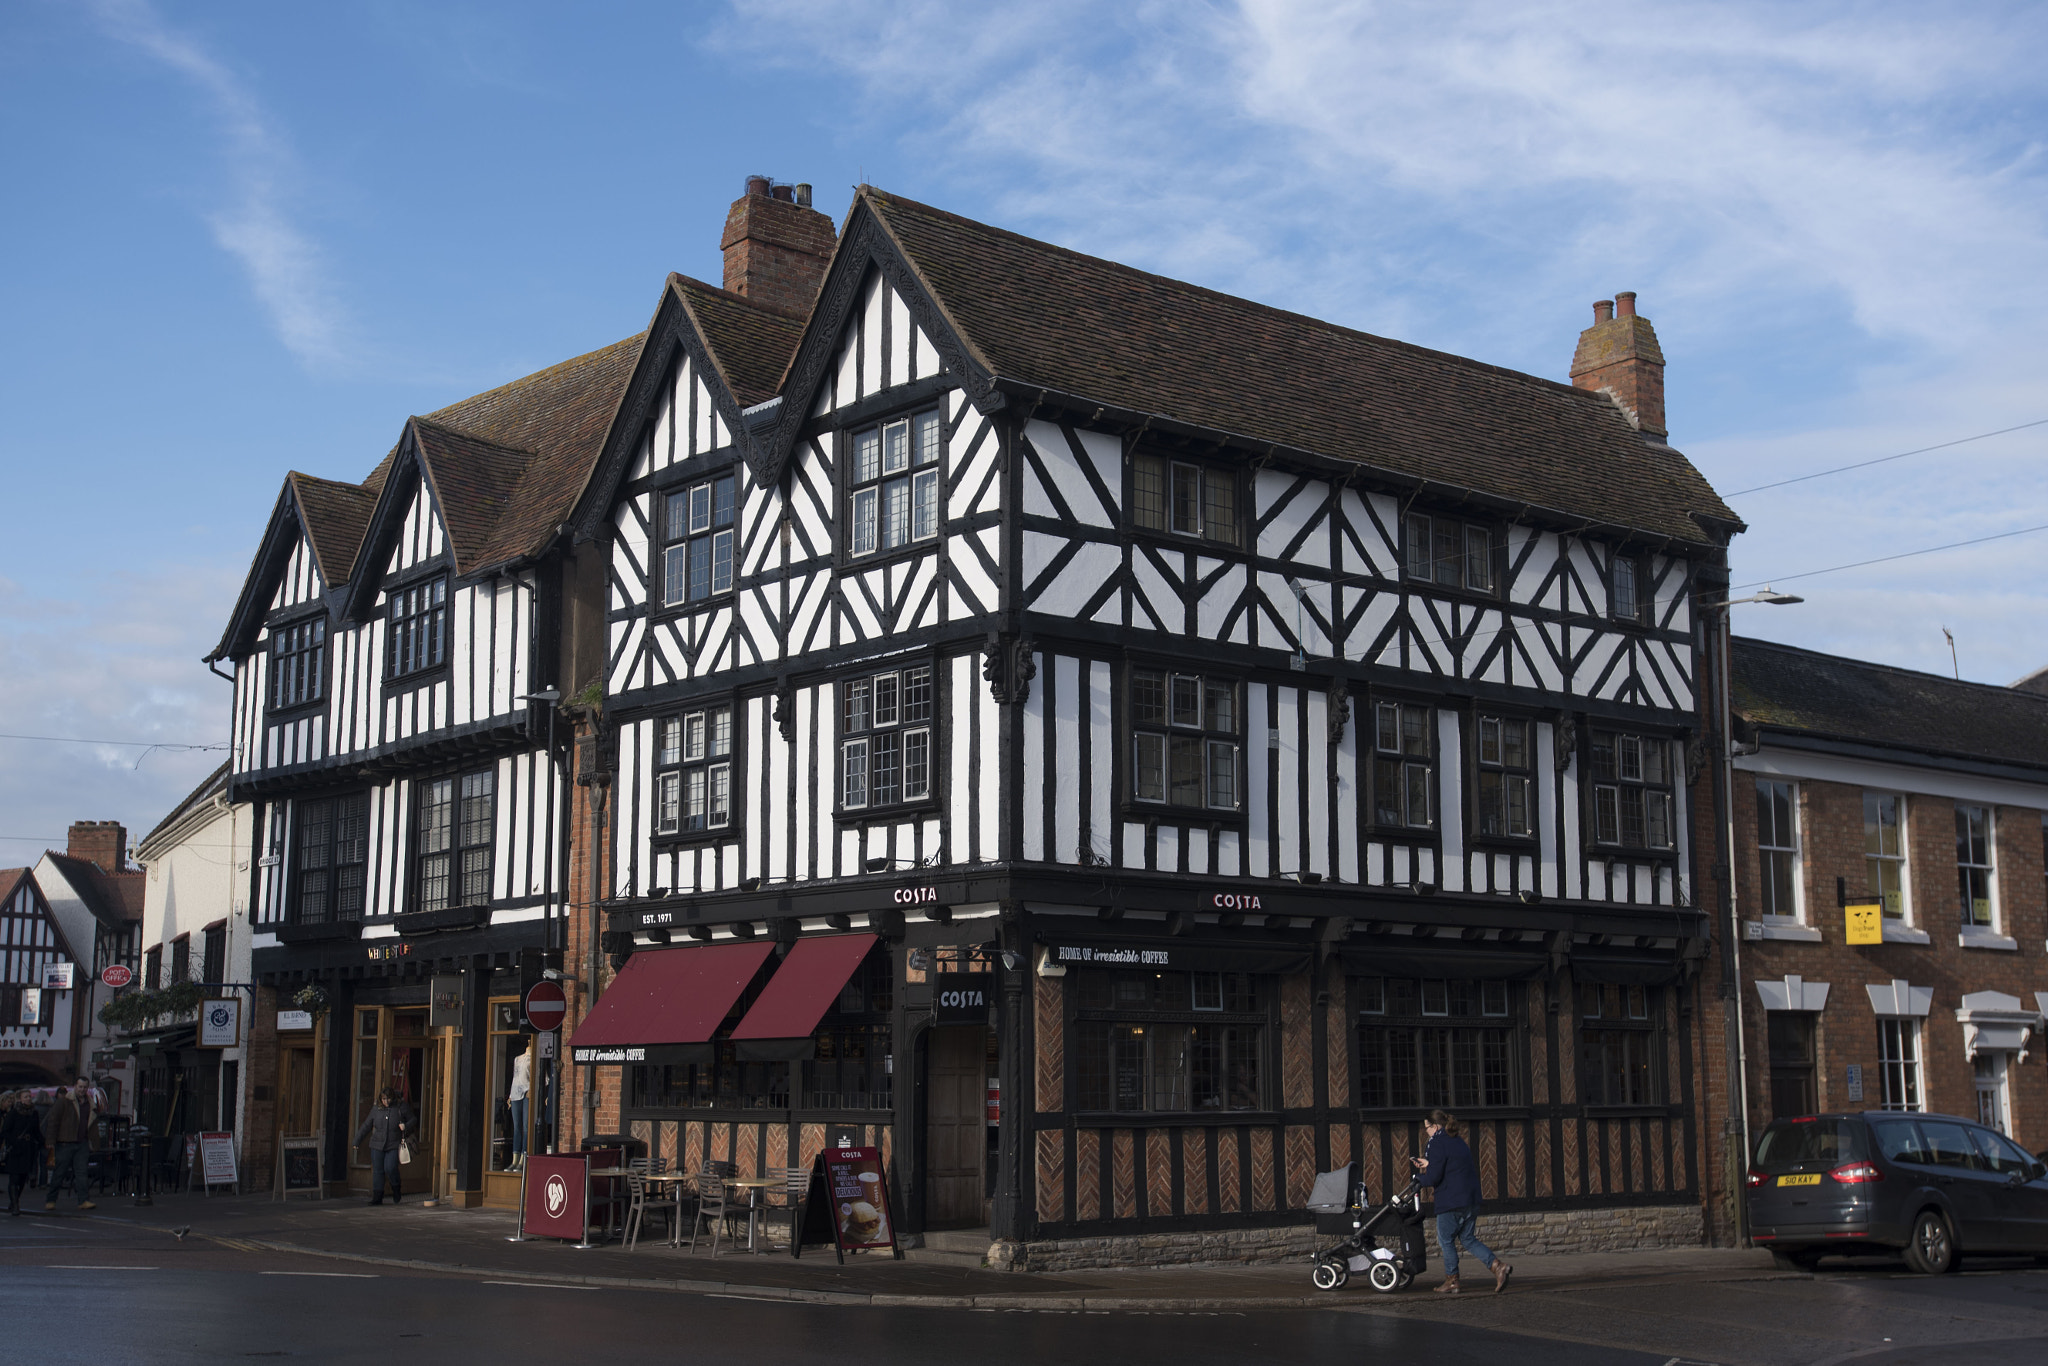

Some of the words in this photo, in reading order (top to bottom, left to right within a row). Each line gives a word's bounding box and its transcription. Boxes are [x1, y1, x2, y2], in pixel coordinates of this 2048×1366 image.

[260, 857, 274, 865] BRIDGE
[894, 887, 937, 904] COSTA
[1213, 893, 1261, 910] COSTA
[643, 914, 656, 924] EST.
[657, 913, 672, 923] 1971
[368, 945, 390, 961] WHITE
[390, 943, 413, 958] STUFF
[1058, 946, 1082, 960] HOME
[1082, 947, 1092, 960] OF
[1093, 948, 1140, 963] irresistible
[1141, 950, 1169, 964] COFFEE
[940, 990, 984, 1009] COSTA
[0, 1040, 15, 1048] DS
[19, 1040, 47, 1048] WALK
[626, 1048, 645, 1061] COFFEE
[1798, 1174, 1814, 1184] KAY
[836, 1187, 862, 1196] DELICIOUS
